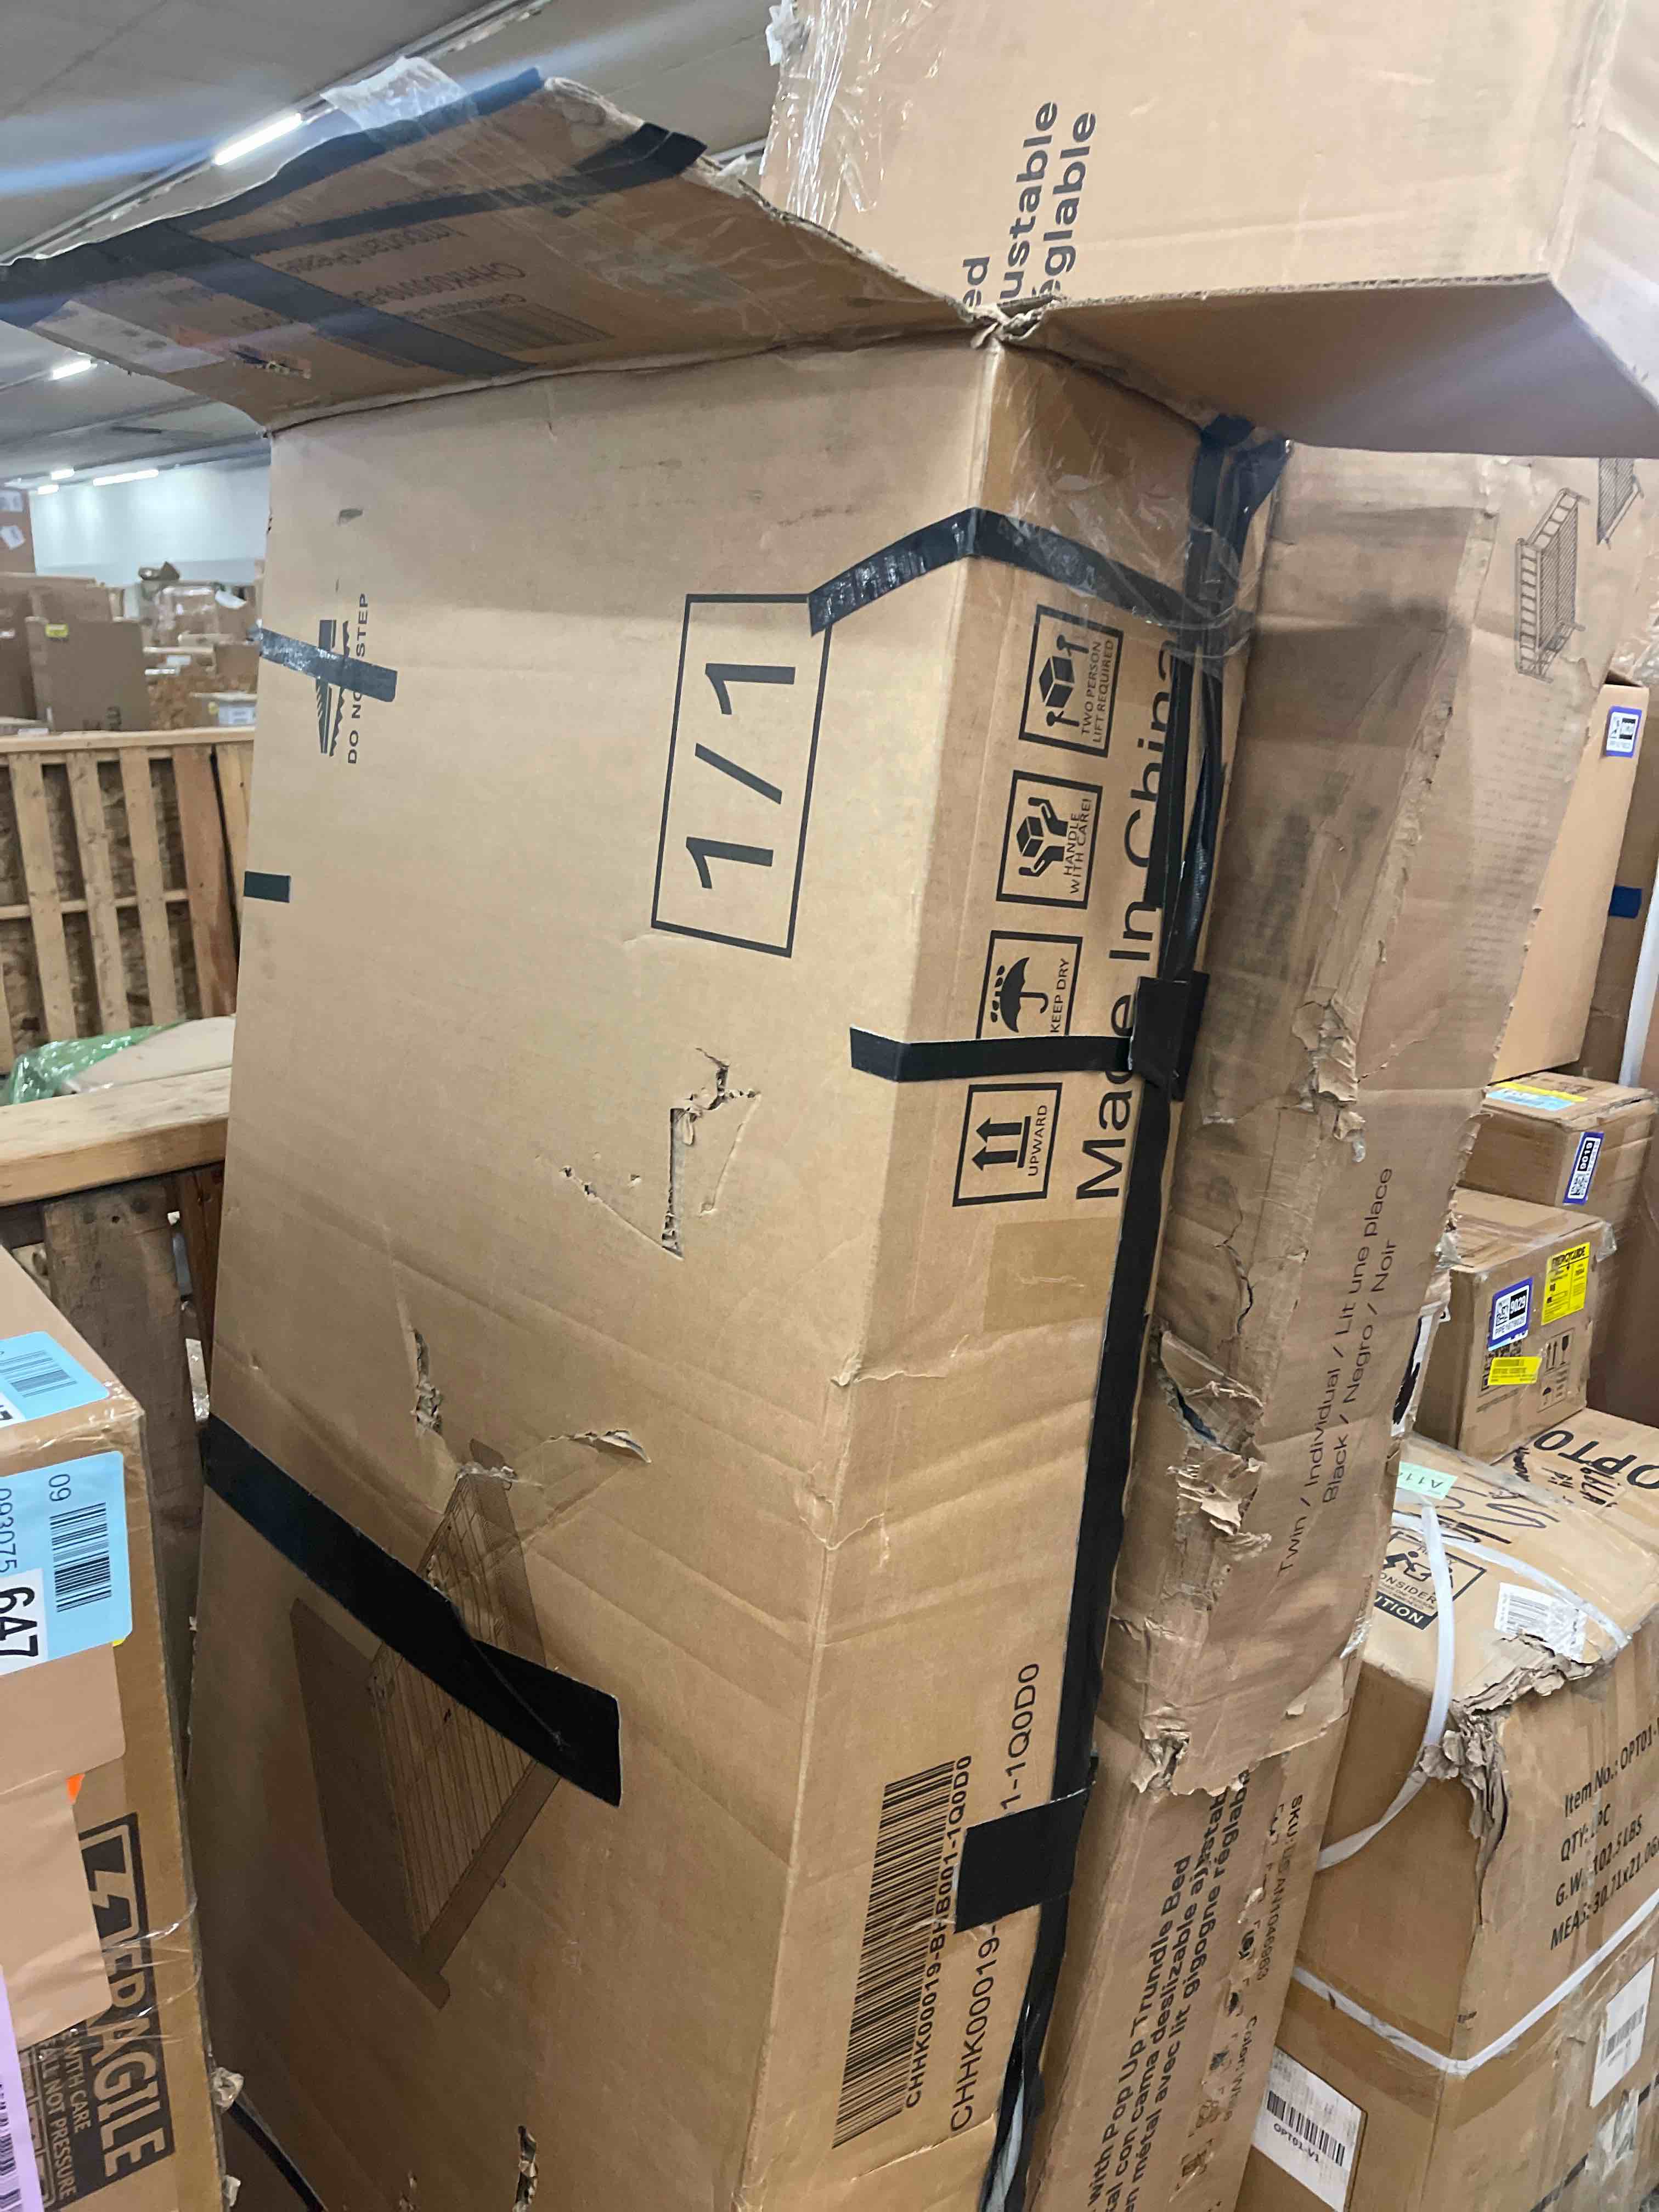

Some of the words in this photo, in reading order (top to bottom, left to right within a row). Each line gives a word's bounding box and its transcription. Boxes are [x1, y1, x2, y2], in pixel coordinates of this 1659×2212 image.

[1000, 101, 1058, 300] ustable
[348, 730, 359, 764] DO
[356, 594, 369, 657] STEP
[1086, 641, 1101, 698] PERSON
[1097, 640, 1114, 712] REQUIRED
[1081, 701, 1093, 736] TWO
[1093, 715, 1104, 743] LIFT
[685, 662, 796, 889] 1/1
[1063, 812, 1080, 876] HANDLE
[1077, 798, 1092, 846] CARE!
[1070, 853, 1085, 894] WITH
[1109, 900, 1163, 961] In
[1050, 995, 1063, 1032] KEEP
[1057, 958, 1069, 990] DRY
[1028, 1104, 1048, 1176] UPWARD
[1278, 1516, 1307, 1577] Twin
[1305, 1368, 1341, 1487] Individual
[1335, 1302, 1356, 1335] Lit
[1349, 1246, 1370, 1295] une
[1364, 1167, 1392, 1237] place
[1323, 1434, 1350, 1503] Black
[1343, 1324, 1373, 1404] Negro
[1371, 1240, 1397, 1293] Noir
[49, 1473, 72, 1502] 09
[0, 1587, 39, 1657] 647
[1565, 1782, 1592, 1818] Item
[1620, 1717, 1659, 1770] OPT01-
[1561, 1822, 1589, 1861] QTY:
[1160, 1855, 1192, 1916] Bed
[1130, 1921, 1173, 2038] Trundle
[1115, 2128, 1138, 2177] con
[1131, 2050, 1160, 2123] cama
[1152, 1903, 1198, 2045] deslizable
[1118, 2039, 1147, 2083] Up
[1132, 2108, 1162, 2182] métal
[1155, 2040, 1181, 2103] avec
[1169, 2004, 1192, 2039] lit
[1183, 1884, 1221, 2001] gigogne
[44, 2079, 65, 2115] NOT
[70, 2090, 92, 2134] CARE
[1102, 2085, 1134, 2143] Pop
[50, 2116, 77, 2200] PRESSURE
[1087, 2145, 1114, 2206] with
